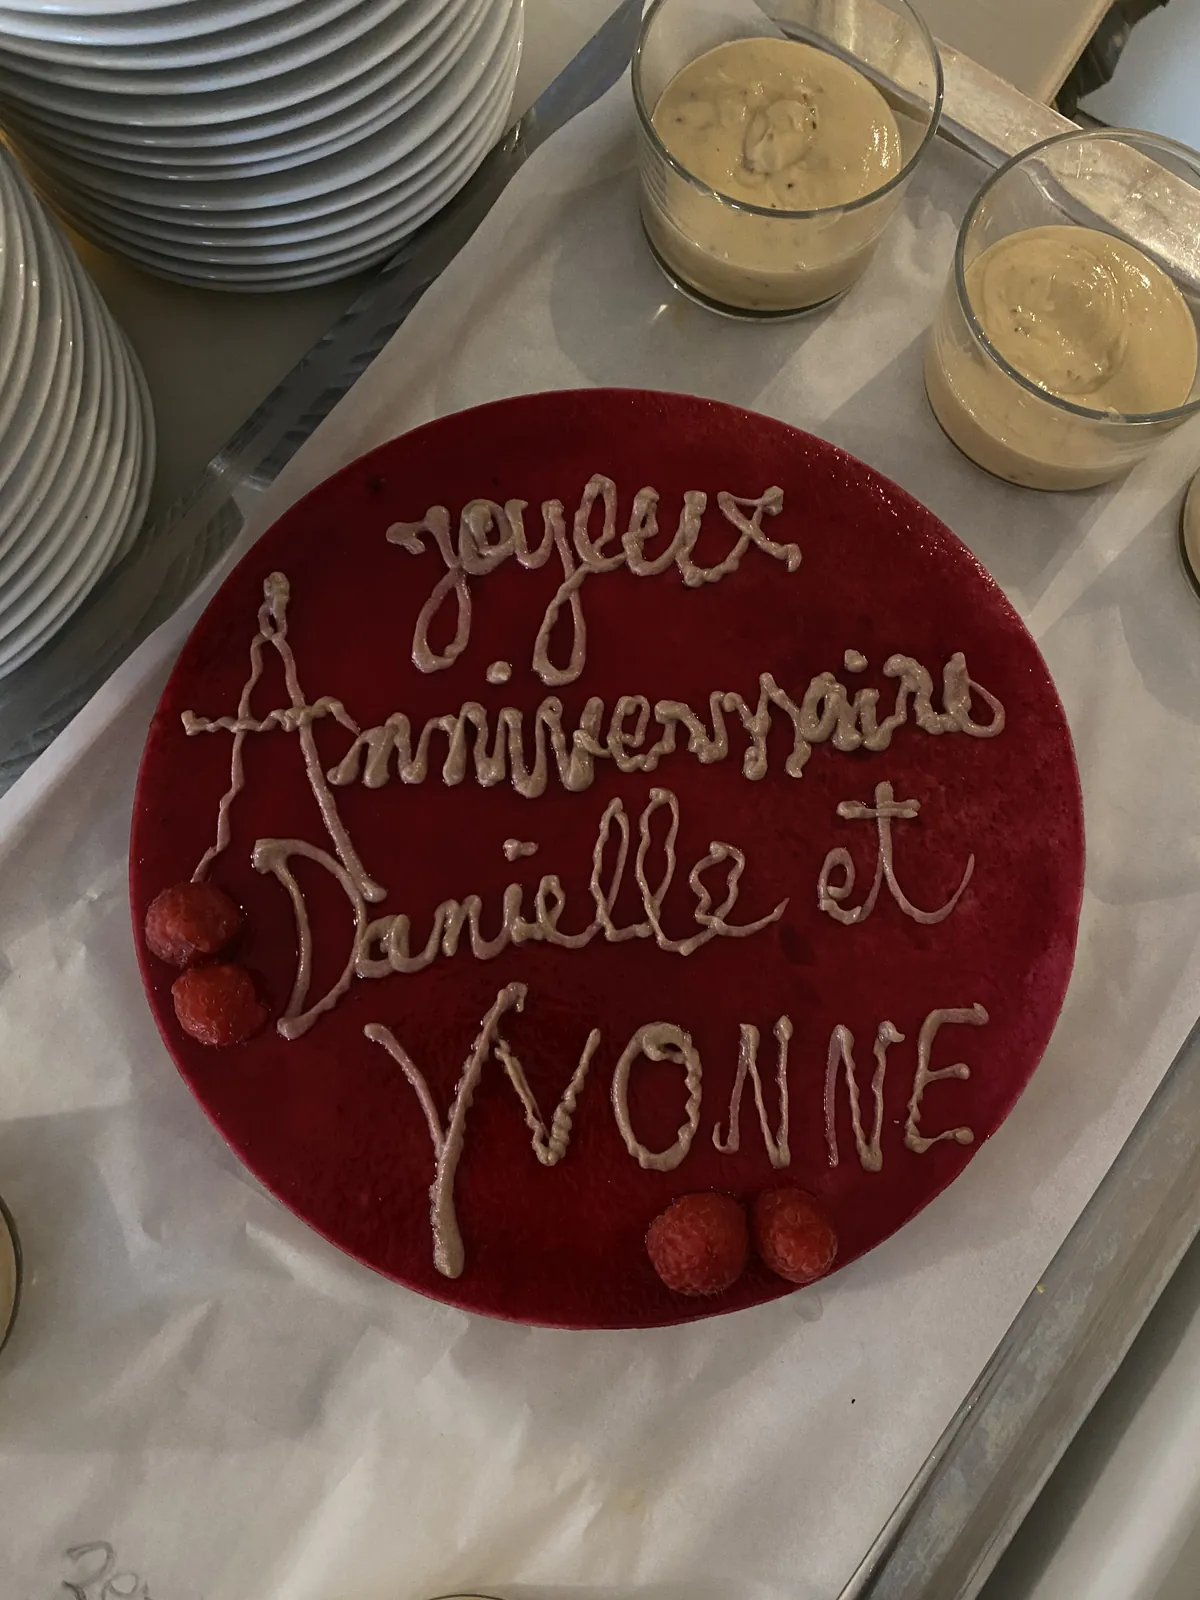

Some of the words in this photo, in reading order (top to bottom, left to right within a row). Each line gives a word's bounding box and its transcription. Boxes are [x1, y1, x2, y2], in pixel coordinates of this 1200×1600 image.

[251, 787, 790, 1039] Danielle
[817, 781, 975, 925] et
[364, 982, 990, 1278] YVONNE
